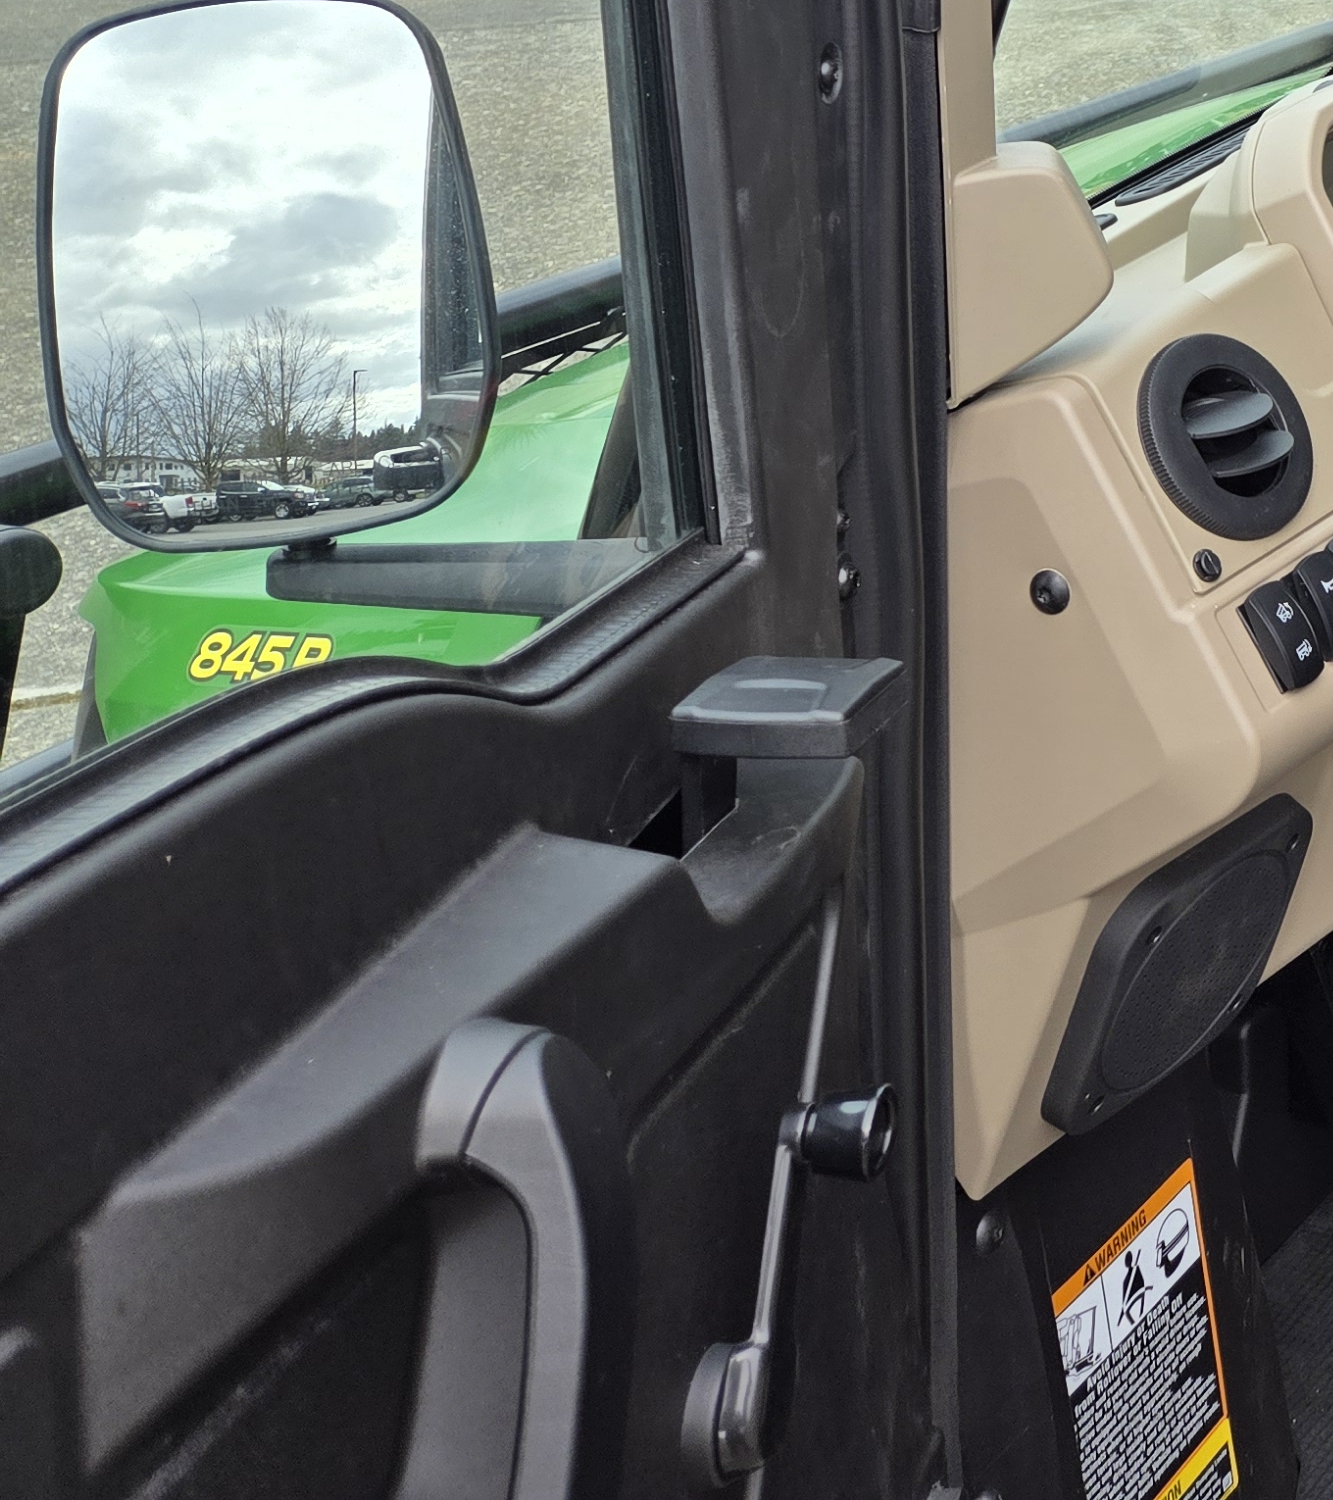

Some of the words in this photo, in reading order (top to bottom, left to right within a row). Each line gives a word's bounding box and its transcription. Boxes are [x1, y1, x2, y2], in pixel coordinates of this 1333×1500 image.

[1094, 1209, 1147, 1272] WARNING
[1074, 1386, 1095, 1420] from
[1096, 1346, 1132, 1397] Rollover
[1132, 1337, 1142, 1357] or
[1142, 1305, 1170, 1348] Falling
[1170, 1291, 1183, 1315] Off
[1085, 1356, 1110, 1394] Avoid
[1111, 1328, 1136, 1367] Injury
[1136, 1319, 1146, 1339] or
[1146, 1292, 1169, 1327] Death
